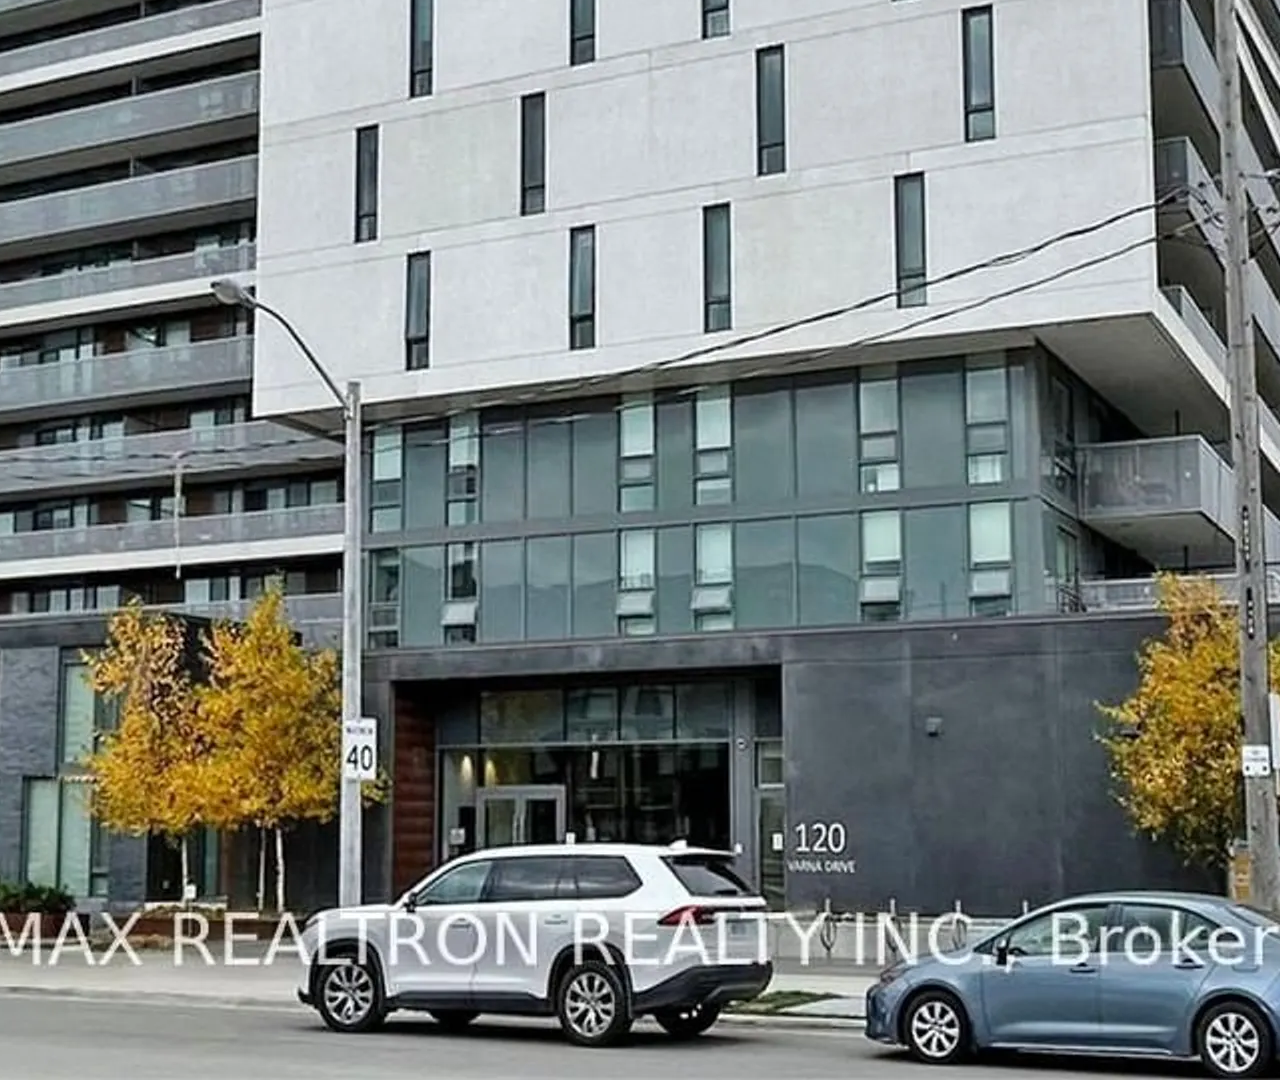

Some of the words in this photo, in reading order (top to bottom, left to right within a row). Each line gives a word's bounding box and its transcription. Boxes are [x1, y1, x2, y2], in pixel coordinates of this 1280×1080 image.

[346, 745, 373, 770] 40
[796, 823, 846, 853] 120
[824, 860, 856, 873] DRIVE
